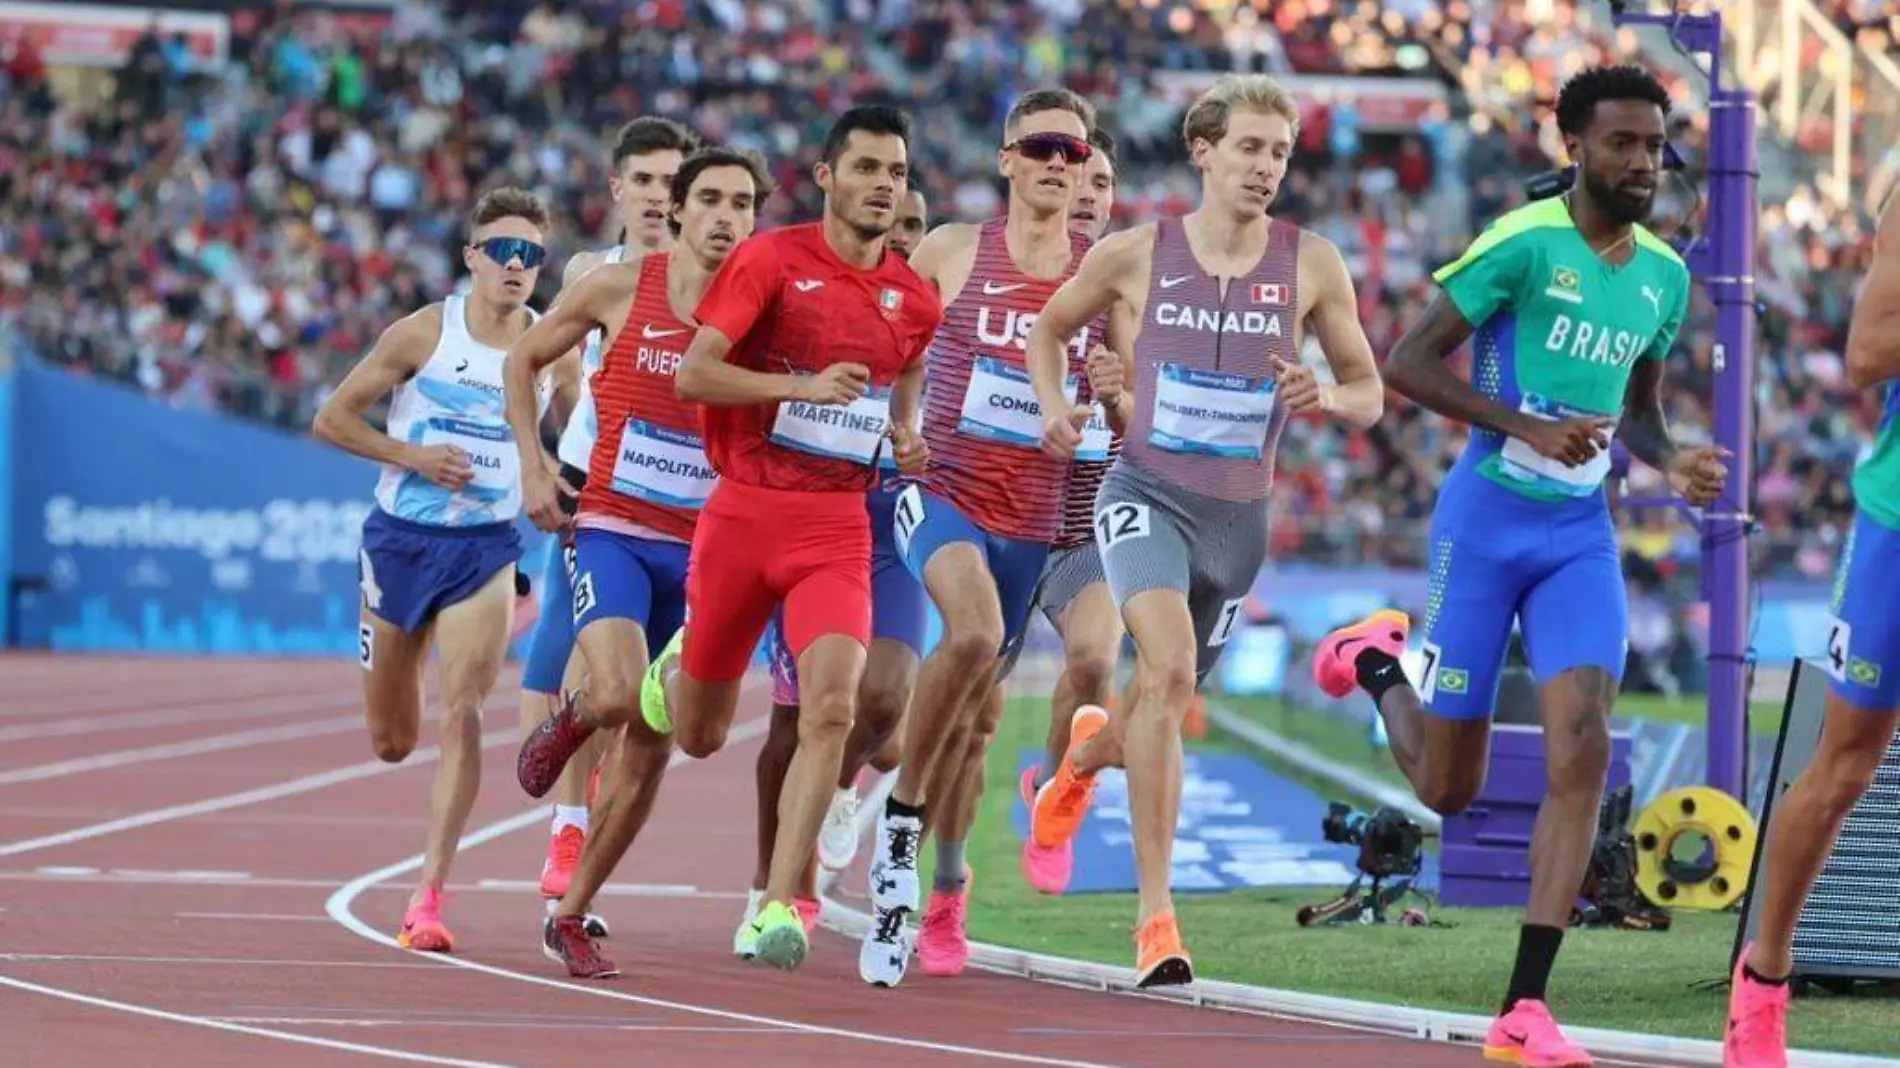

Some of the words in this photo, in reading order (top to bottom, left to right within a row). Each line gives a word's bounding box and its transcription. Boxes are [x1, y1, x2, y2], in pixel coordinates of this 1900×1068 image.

[1155, 302, 1282, 337] CANADA
[635, 347, 684, 376] PUER
[787, 401, 885, 434] MARTINEZ
[987, 393, 1043, 416] COMB
[44, 494, 258, 560] Santiago
[260, 496, 378, 562] 202
[1098, 504, 1141, 544] 12
[360, 628, 371, 662] 5
[1827, 625, 1844, 672] 4
[1420, 646, 1437, 691] 7
